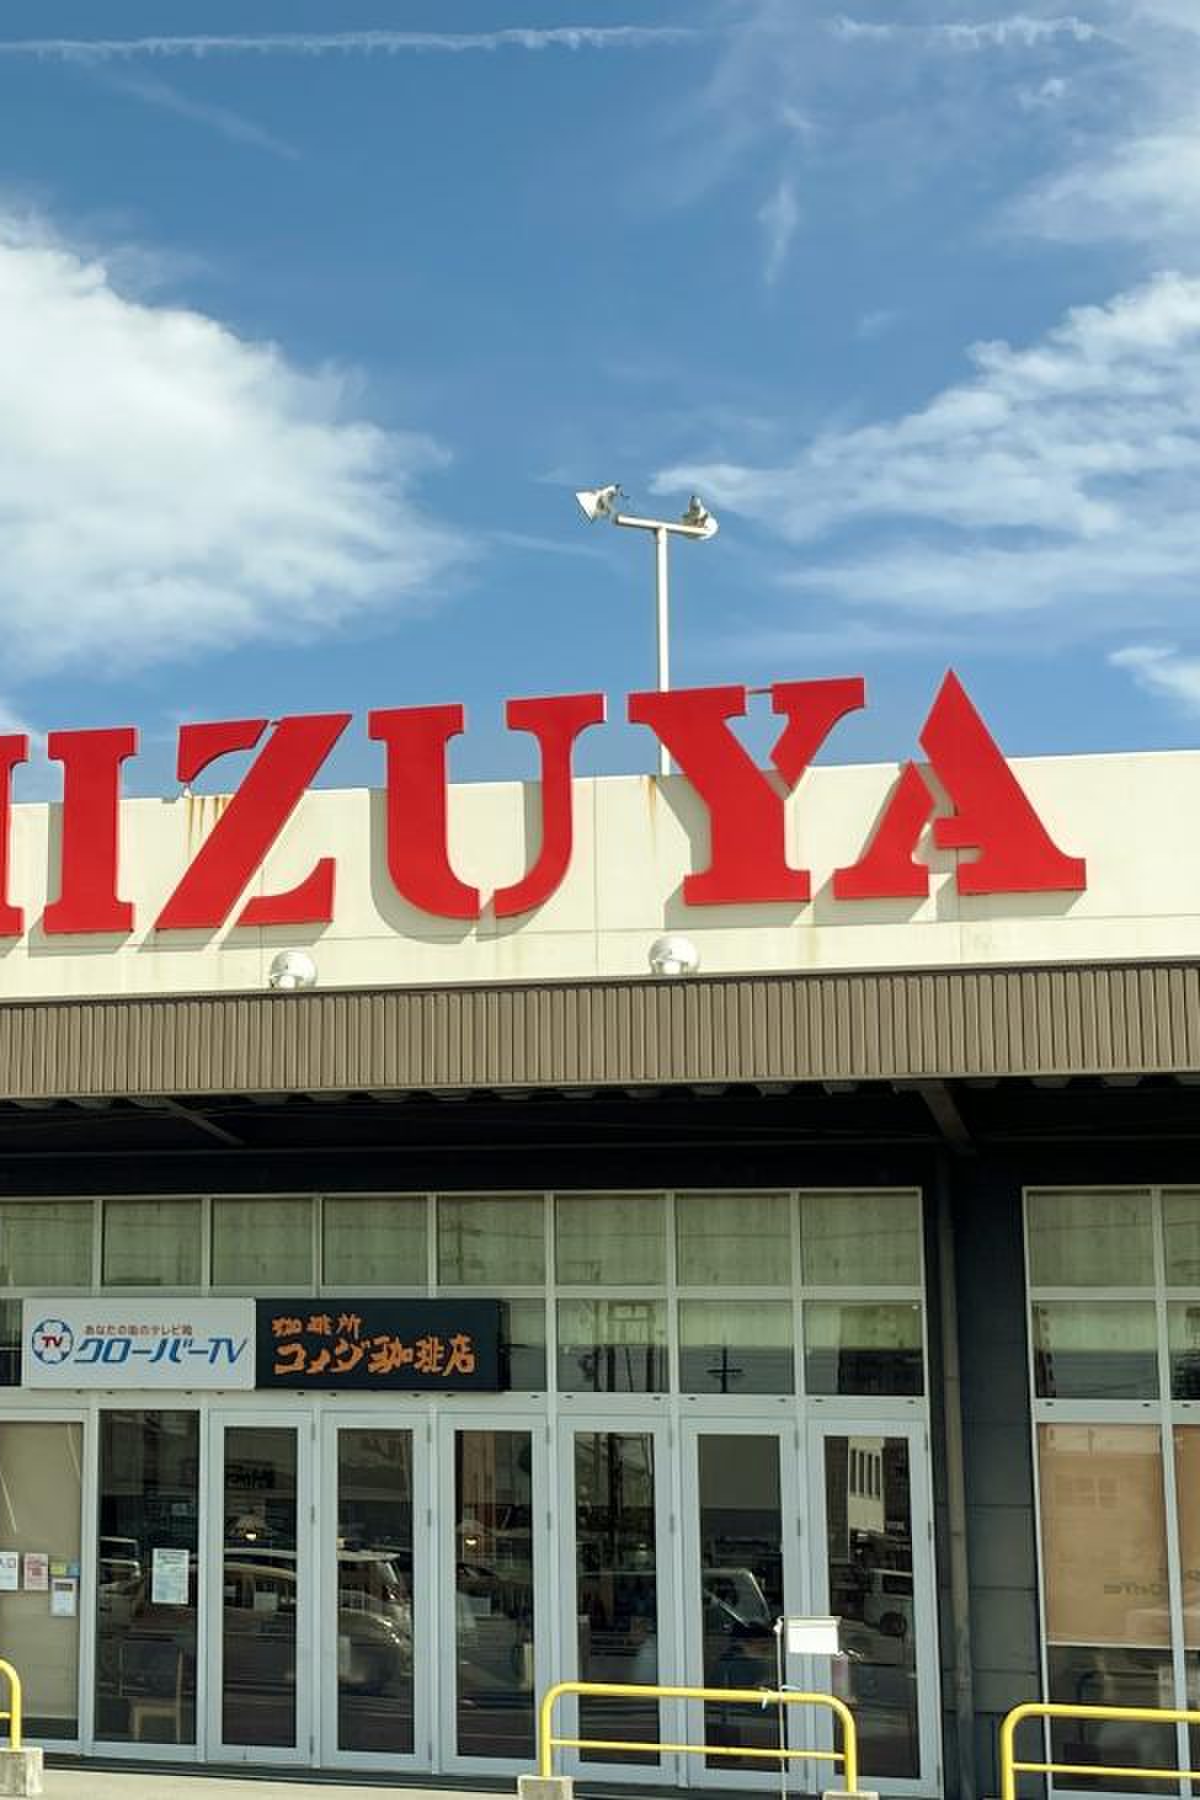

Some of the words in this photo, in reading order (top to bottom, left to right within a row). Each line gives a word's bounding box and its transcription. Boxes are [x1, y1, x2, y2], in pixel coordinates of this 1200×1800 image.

[42, 1335, 63, 1348] TV
[74, 1337, 248, 1364] クローバーTV
[274, 1333, 476, 1376] コメダ珈琲店
